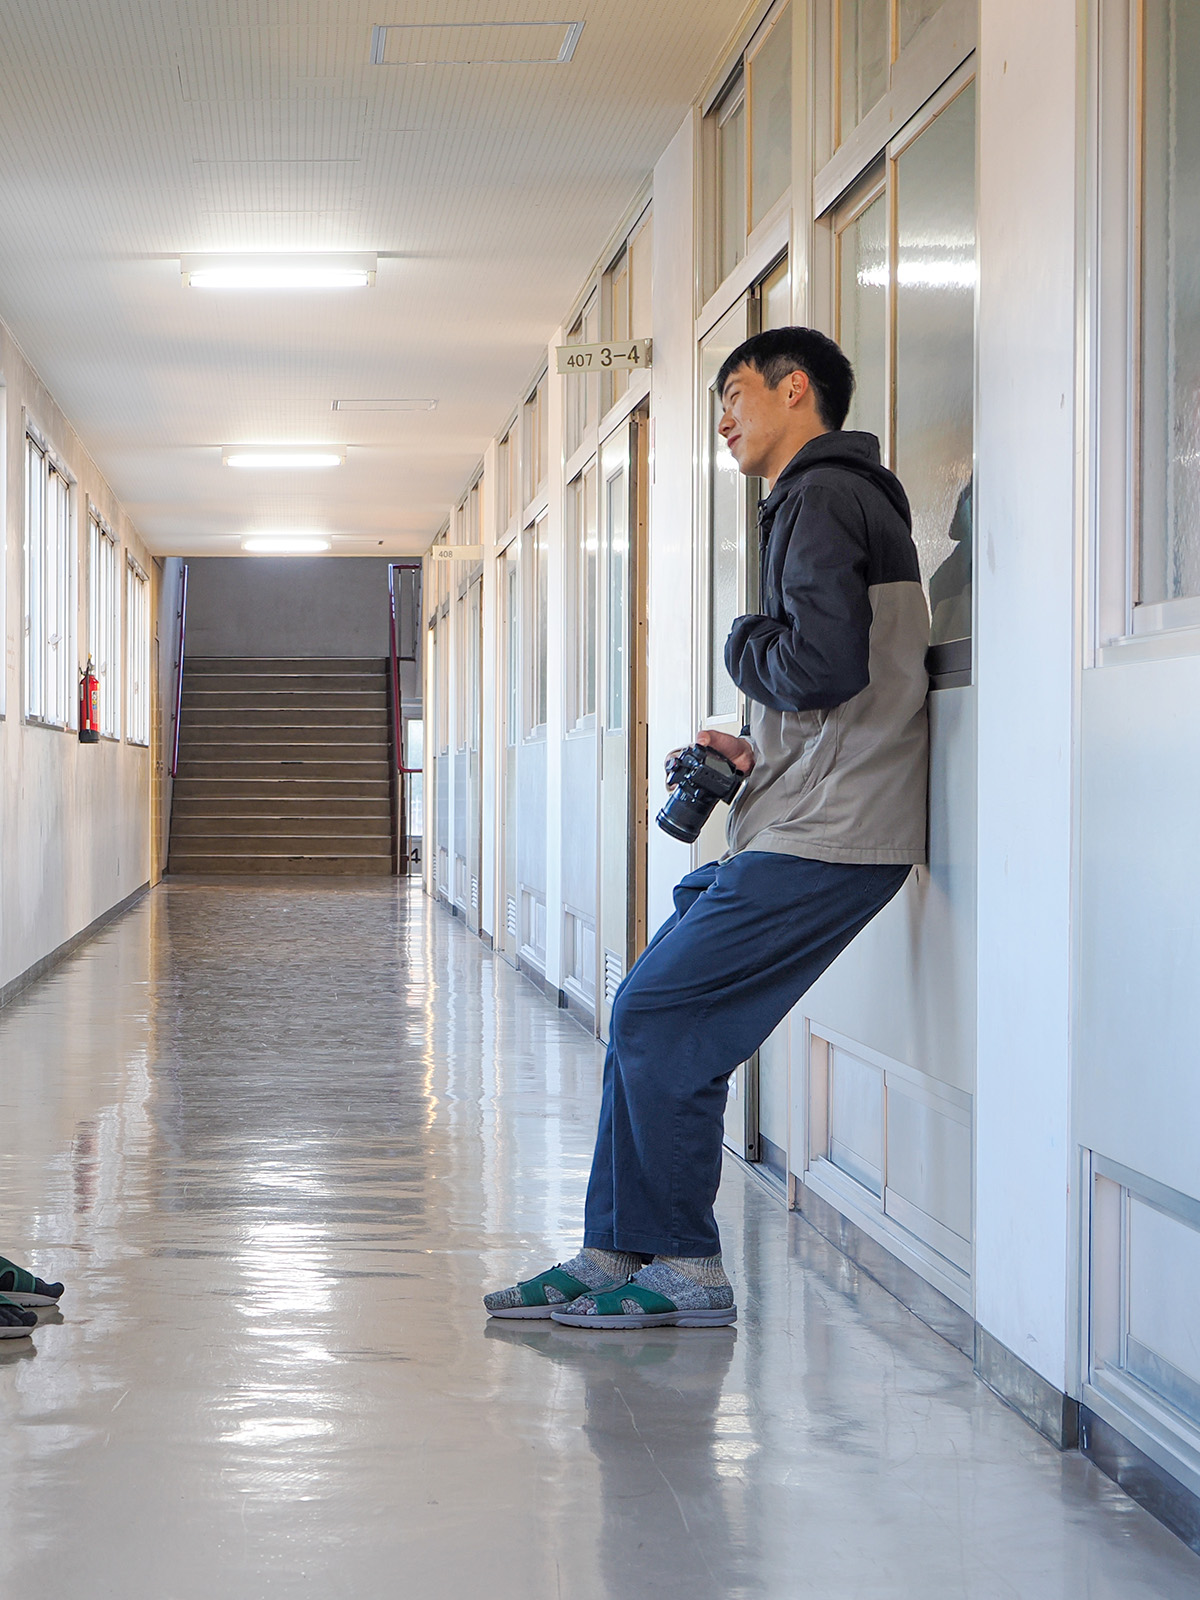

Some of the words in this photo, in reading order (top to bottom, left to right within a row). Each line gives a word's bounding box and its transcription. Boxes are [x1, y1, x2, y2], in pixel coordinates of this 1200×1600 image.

[567, 353, 593, 367] 407
[600, 345, 640, 367] 3-4
[438, 550, 453, 558] 408
[407, 848, 421, 864] 4
